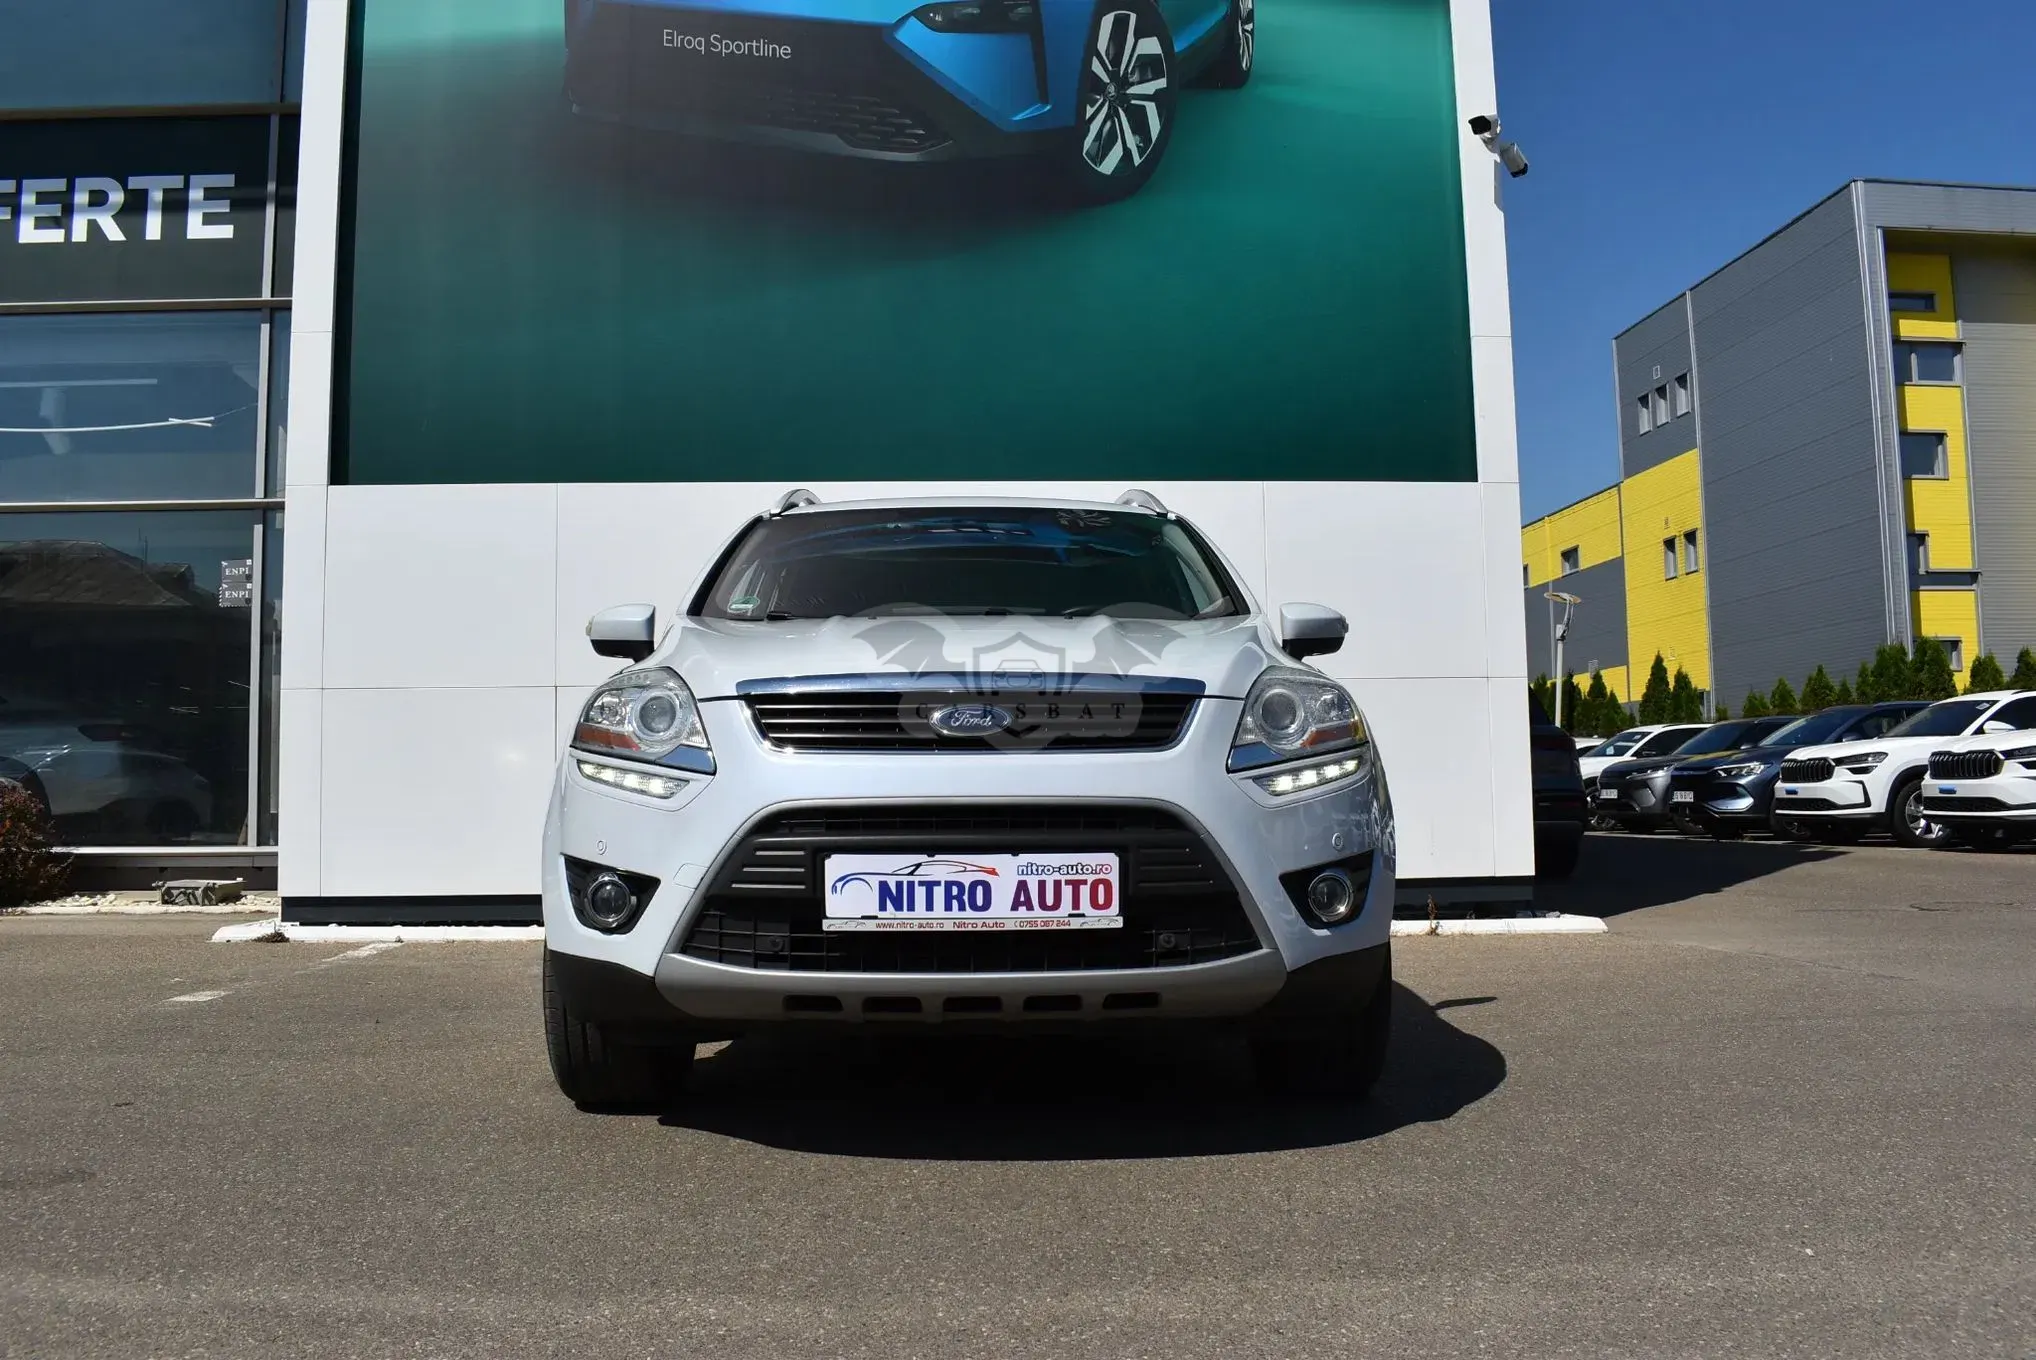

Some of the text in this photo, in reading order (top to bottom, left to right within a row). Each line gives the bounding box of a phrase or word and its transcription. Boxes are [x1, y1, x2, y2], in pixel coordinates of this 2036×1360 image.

[663, 29, 792, 59] Elroq Sportline
[950, 709, 992, 728] Ford
[1017, 862, 1113, 876] nitro-auto.ro
[878, 878, 1113, 913] NITRO AUTO
[875, 921, 945, 930] www.nitro-auto.ro
[952, 921, 978, 930] Nitro
[980, 920, 1006, 929] Auto
